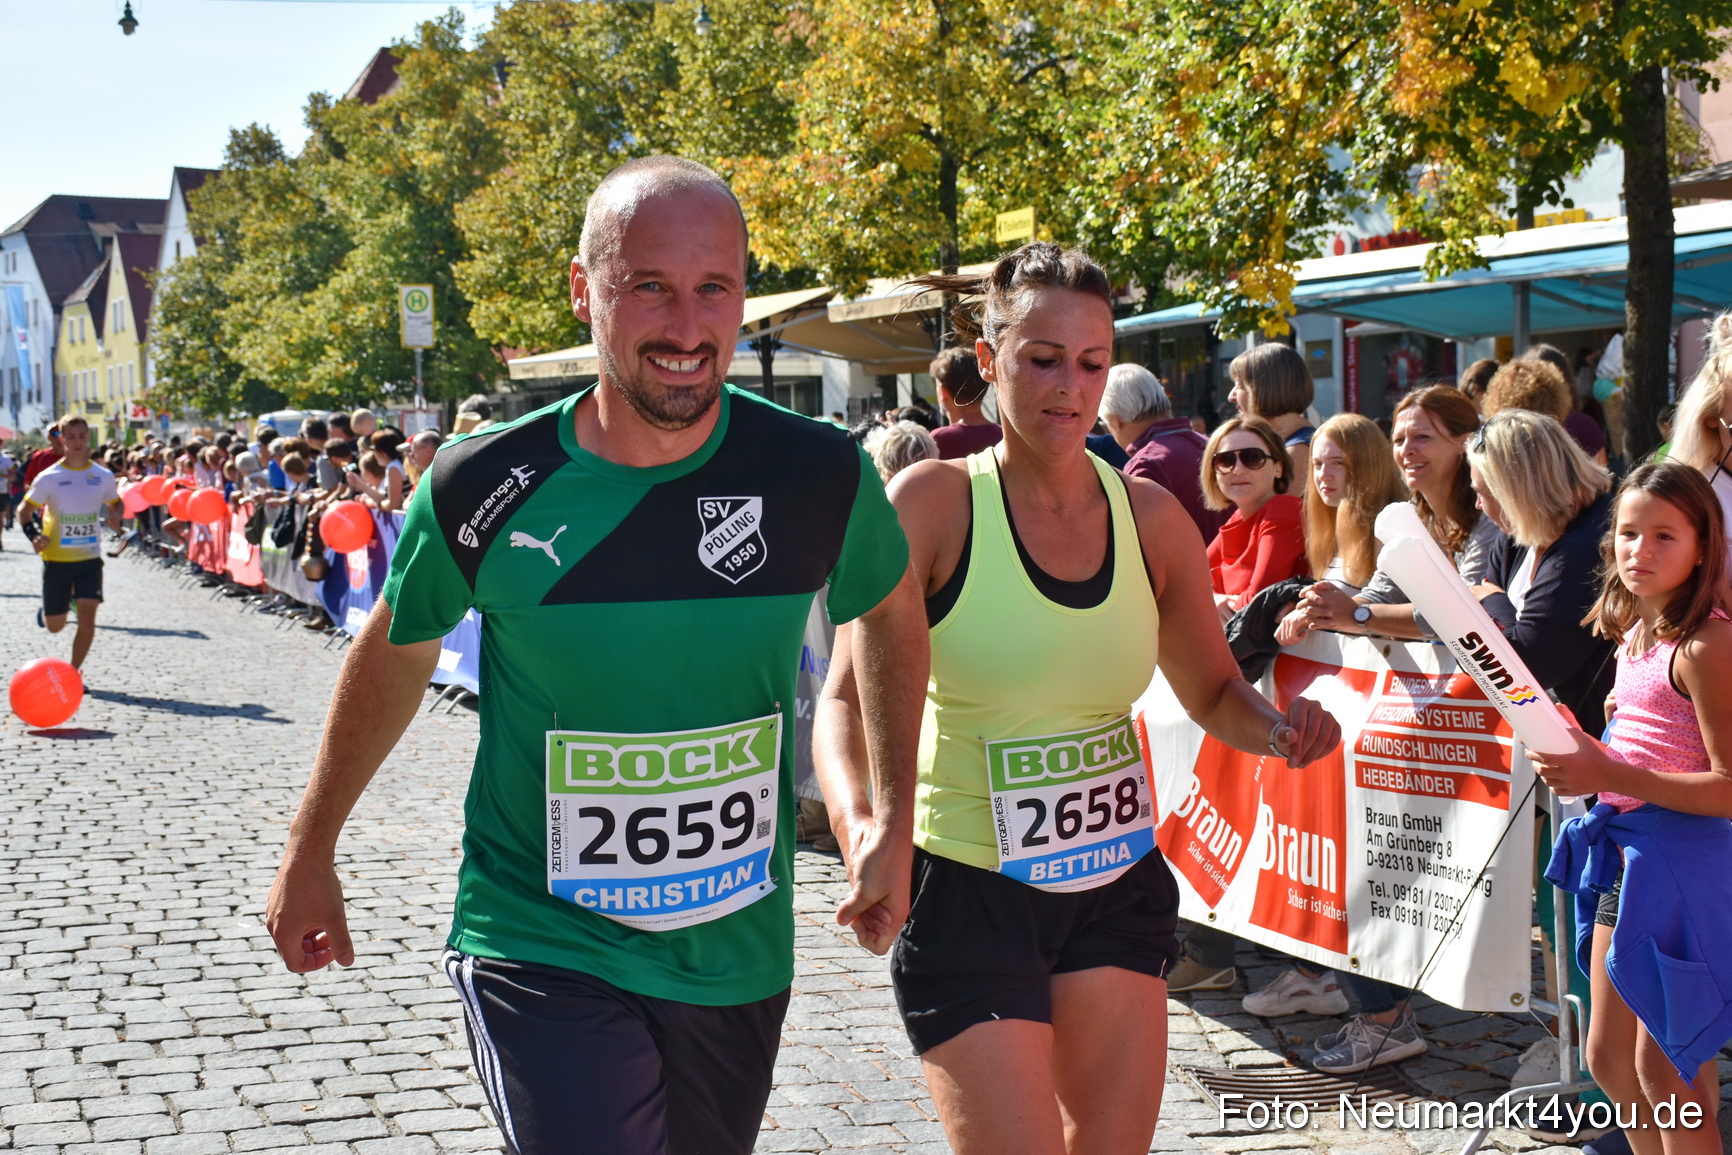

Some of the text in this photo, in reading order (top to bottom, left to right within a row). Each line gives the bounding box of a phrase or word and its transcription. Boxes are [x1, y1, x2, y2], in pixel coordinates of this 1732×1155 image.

[470, 477, 514, 529] sarango
[480, 487, 520, 531] TEAMSPORT
[703, 501, 732, 519] SV
[65, 525, 94, 536] 2423
[704, 511, 756, 556] PÖLLING
[724, 542, 757, 572] 1950
[1449, 640, 1482, 677] stadtwerke
[1480, 676, 1508, 710] neumarkt
[1458, 631, 1514, 690] swn
[568, 731, 759, 784] BOCK
[1005, 727, 1132, 781] BOCK
[1361, 734, 1477, 763] RUNDSCHLINGEN
[760, 788, 769, 799] D
[1362, 767, 1456, 795] HEBEBÄNDER
[578, 791, 755, 865] 2659
[1016, 776, 1140, 848] 2658
[1173, 772, 1243, 872] Braun
[1366, 806, 1443, 833] Braun GmbH
[1029, 841, 1132, 881] BETTINA
[1187, 840, 1206, 865] Sicher
[1203, 859, 1215, 874] ist
[1259, 803, 1337, 894] Braun
[1366, 828, 1452, 860] Am Grünberg 8
[1366, 849, 1414, 873] D-92318
[574, 861, 754, 910] CHRISTIAN
[1368, 880, 1390, 899] Tel.
[1393, 883, 1424, 905] 09181
[1427, 889, 1432, 907] /
[1287, 887, 1348, 922] Sicher ist sicher
[1370, 900, 1391, 920] Fax
[1394, 905, 1424, 928] 09181
[1427, 911, 1432, 929] /
